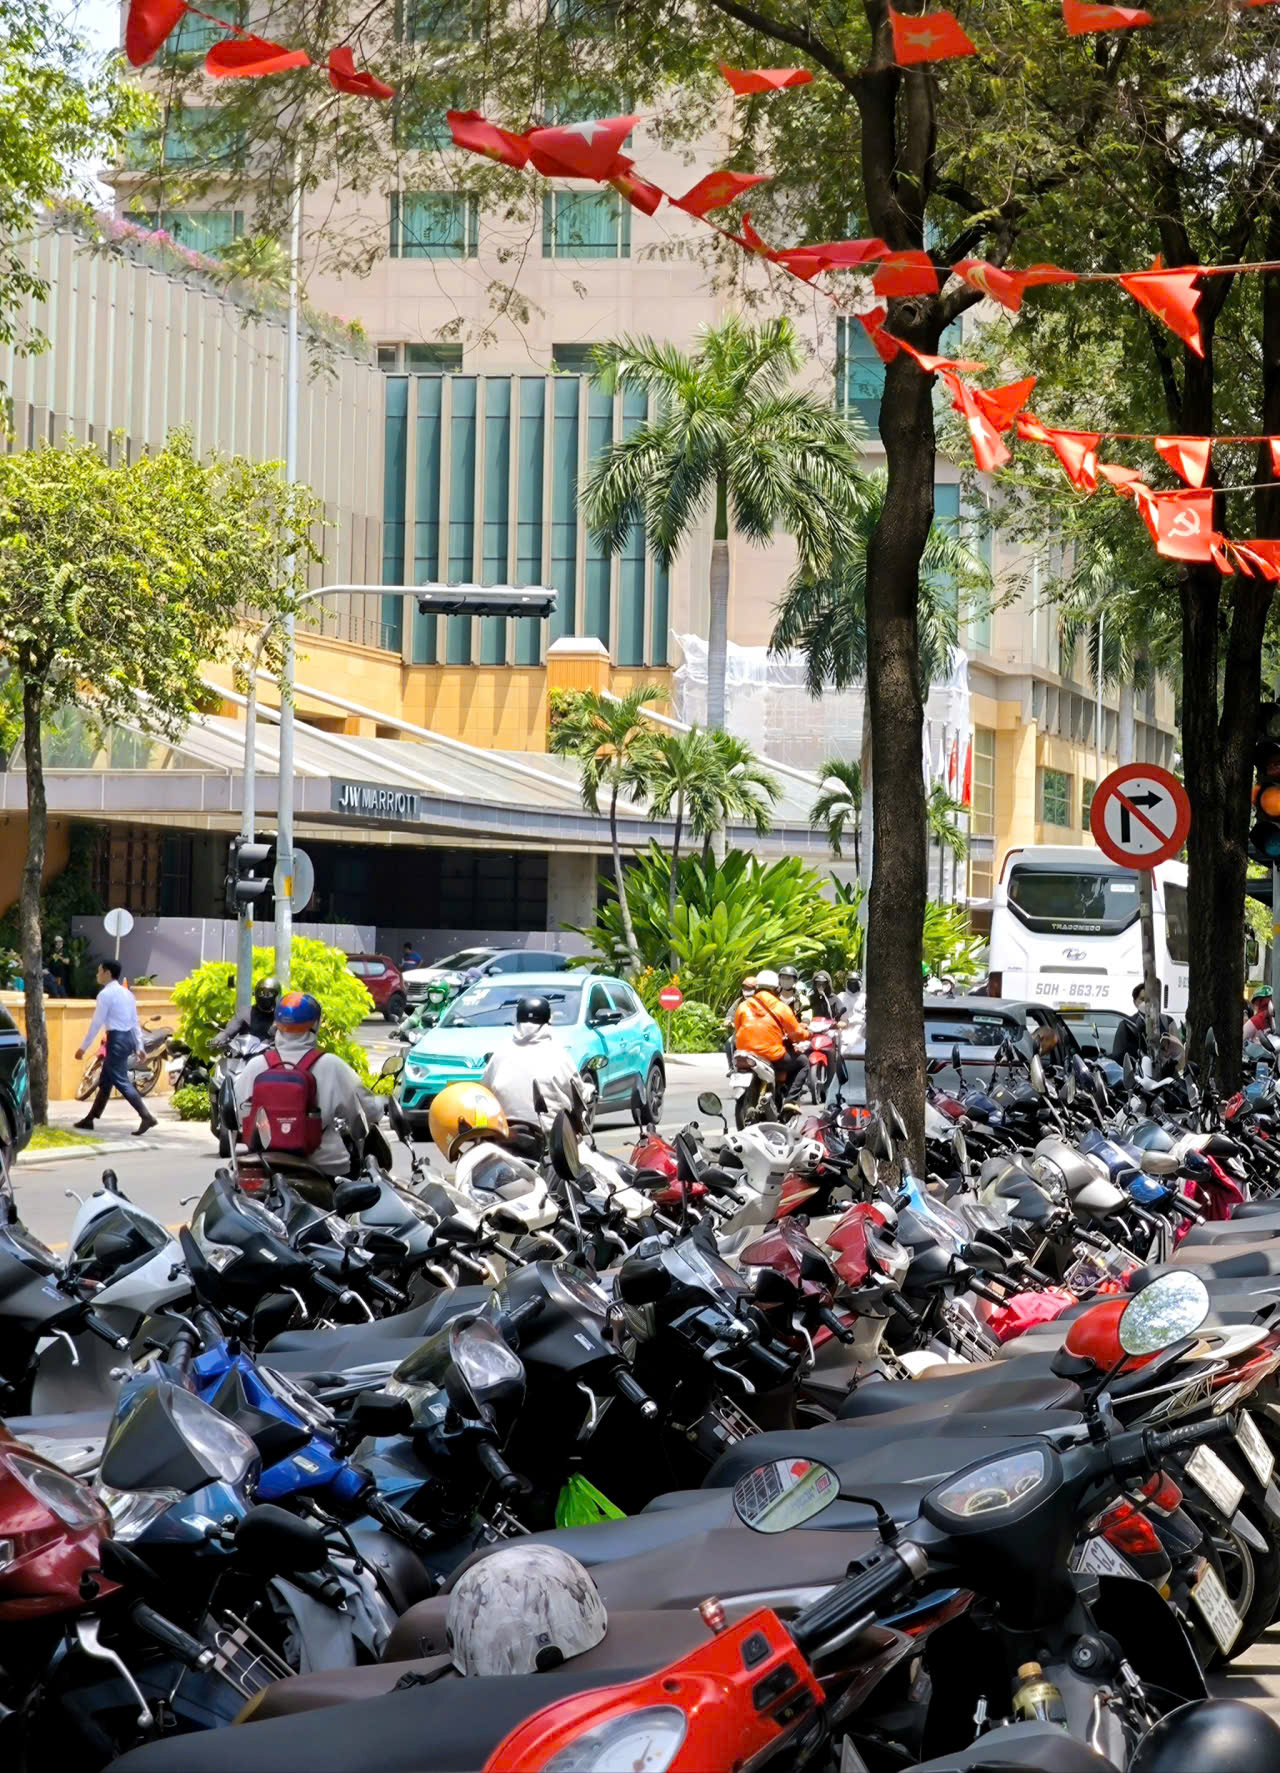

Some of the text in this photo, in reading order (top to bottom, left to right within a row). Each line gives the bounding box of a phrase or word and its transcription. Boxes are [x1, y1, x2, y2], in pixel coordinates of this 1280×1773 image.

[339, 785, 418, 813] JW MARRIOTT
[1069, 984, 1110, 998] 863.75
